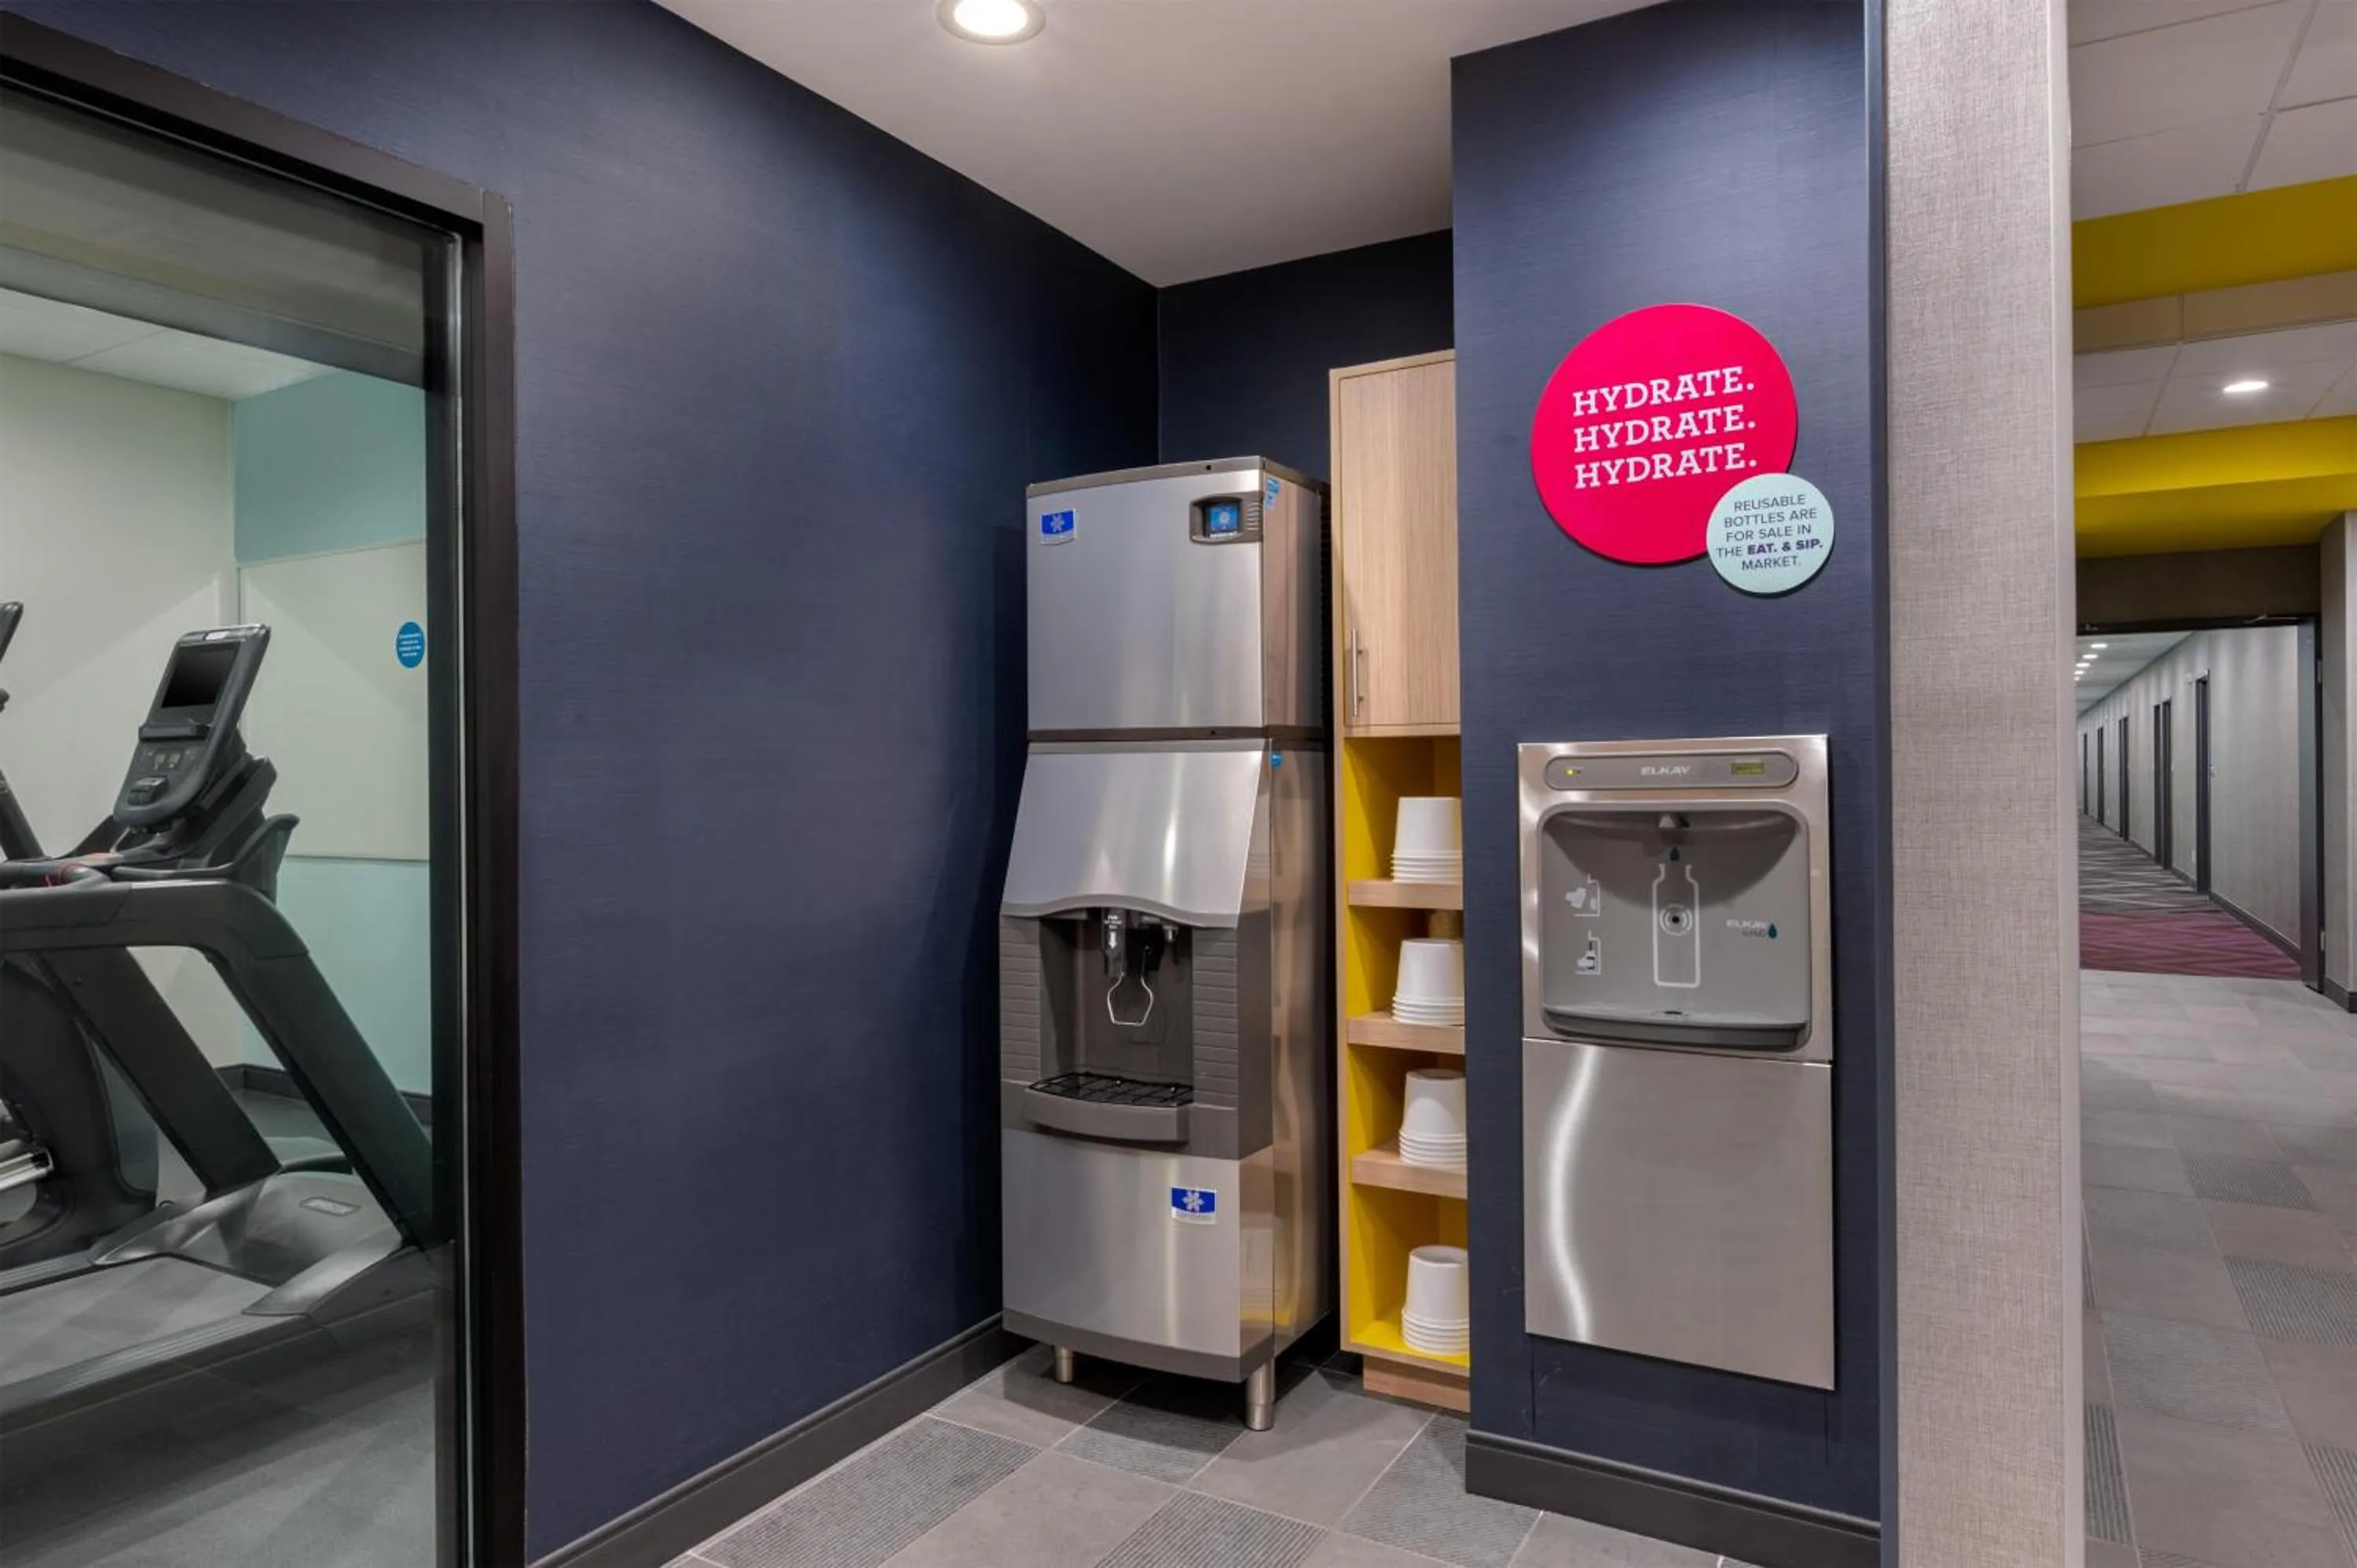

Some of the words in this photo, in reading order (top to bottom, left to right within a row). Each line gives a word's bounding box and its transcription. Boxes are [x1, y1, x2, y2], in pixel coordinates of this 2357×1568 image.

[1573, 365, 1754, 416] HYDRATE.
[1574, 404, 1756, 452] HYDRATE.
[1574, 442, 1757, 489] HYDRATE.
[1734, 494, 1806, 512] REUSABLE
[1724, 511, 1785, 529] BOTTLES
[1789, 507, 1817, 522] ARE
[1725, 530, 1754, 542] FOR
[1758, 526, 1793, 540] SALE
[1797, 524, 1812, 535] IN
[1716, 546, 1743, 558] THE
[1747, 543, 1777, 555] EAT.
[1782, 541, 1792, 552] &
[1795, 538, 1824, 550] SIP.
[1742, 555, 1802, 571] MARKET.
[1640, 766, 1690, 776] ELKAY
